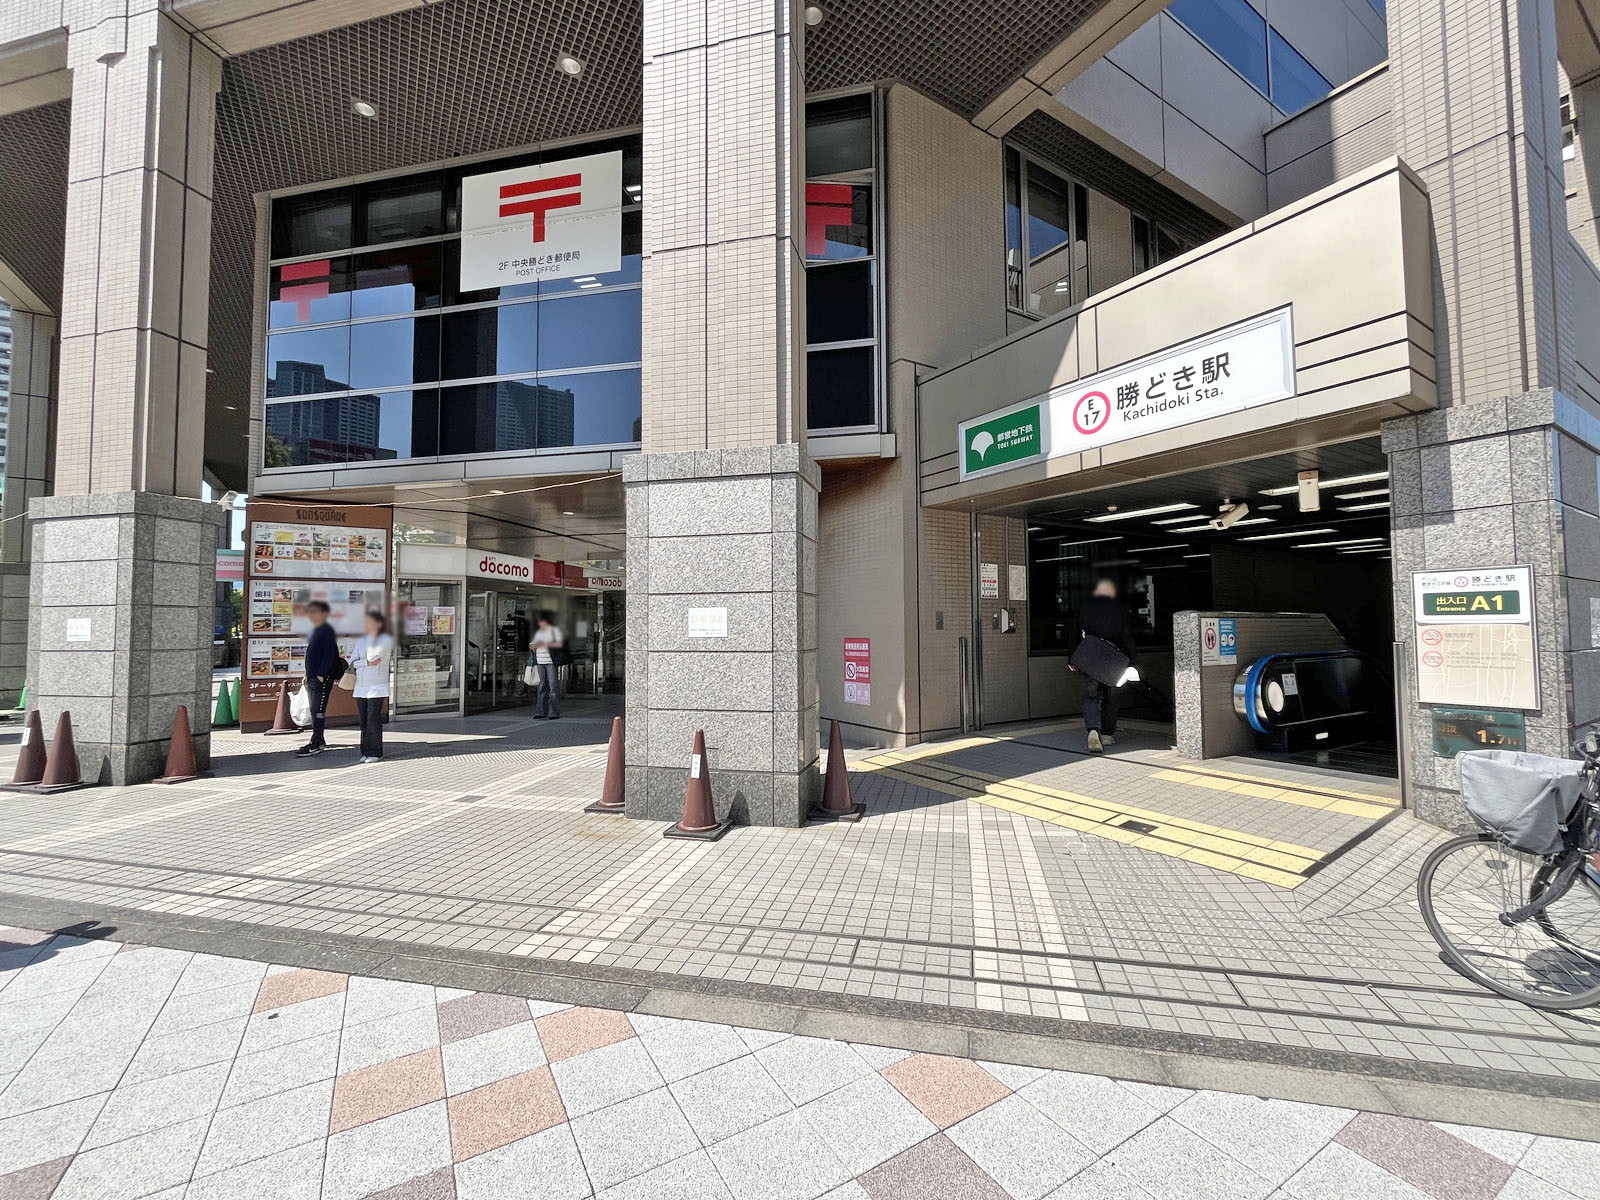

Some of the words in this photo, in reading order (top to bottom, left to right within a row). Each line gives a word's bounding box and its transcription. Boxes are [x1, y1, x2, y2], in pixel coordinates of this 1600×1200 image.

[498, 260, 509, 271] 2F
[511, 250, 581, 269] 中央勝どき郵便局
[515, 268, 534, 277] POST
[535, 264, 560, 275] OFFICE
[1116, 351, 1231, 411] 勝どき駅
[1087, 398, 1095, 411] E
[1123, 393, 1190, 422] Kachidoki
[1195, 386, 1224, 402] Sta.
[1083, 410, 1101, 426] 17
[997, 423, 1033, 442] 都営地下鉄
[997, 441, 1009, 450] TOEI
[1010, 434, 1034, 446] SUBWAY
[479, 556, 529, 578] docomo
[1436, 596, 1467, 605] 出入口
[1470, 595, 1504, 611] A1
